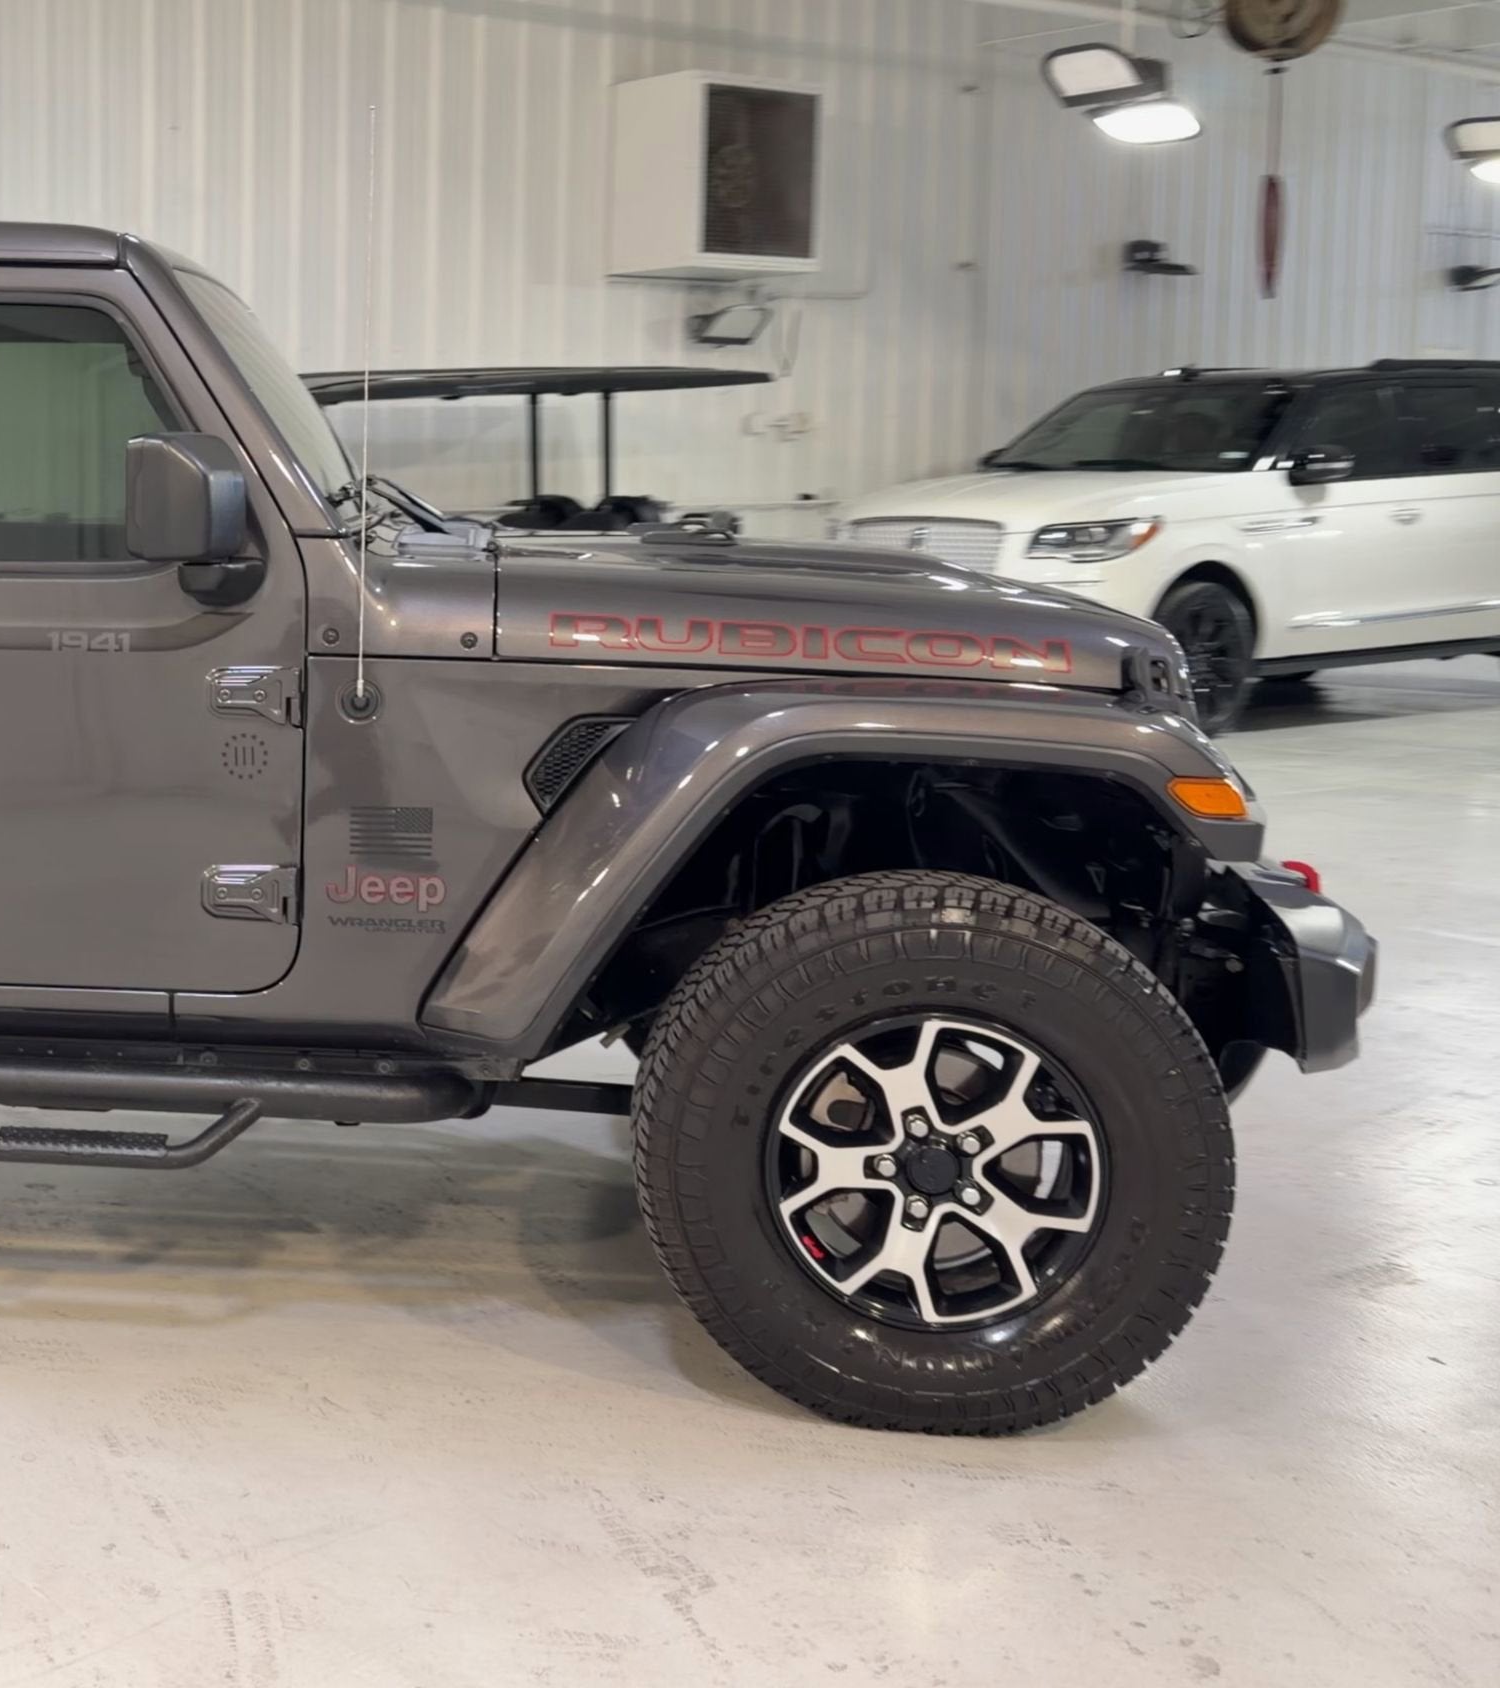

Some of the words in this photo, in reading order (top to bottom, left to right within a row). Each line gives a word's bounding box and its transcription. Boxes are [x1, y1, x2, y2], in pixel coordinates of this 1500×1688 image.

[46, 630, 131, 653] 1941
[548, 611, 1073, 674] RUBICON
[325, 864, 447, 912] Jeep
[328, 915, 446, 930] WRANGLER
